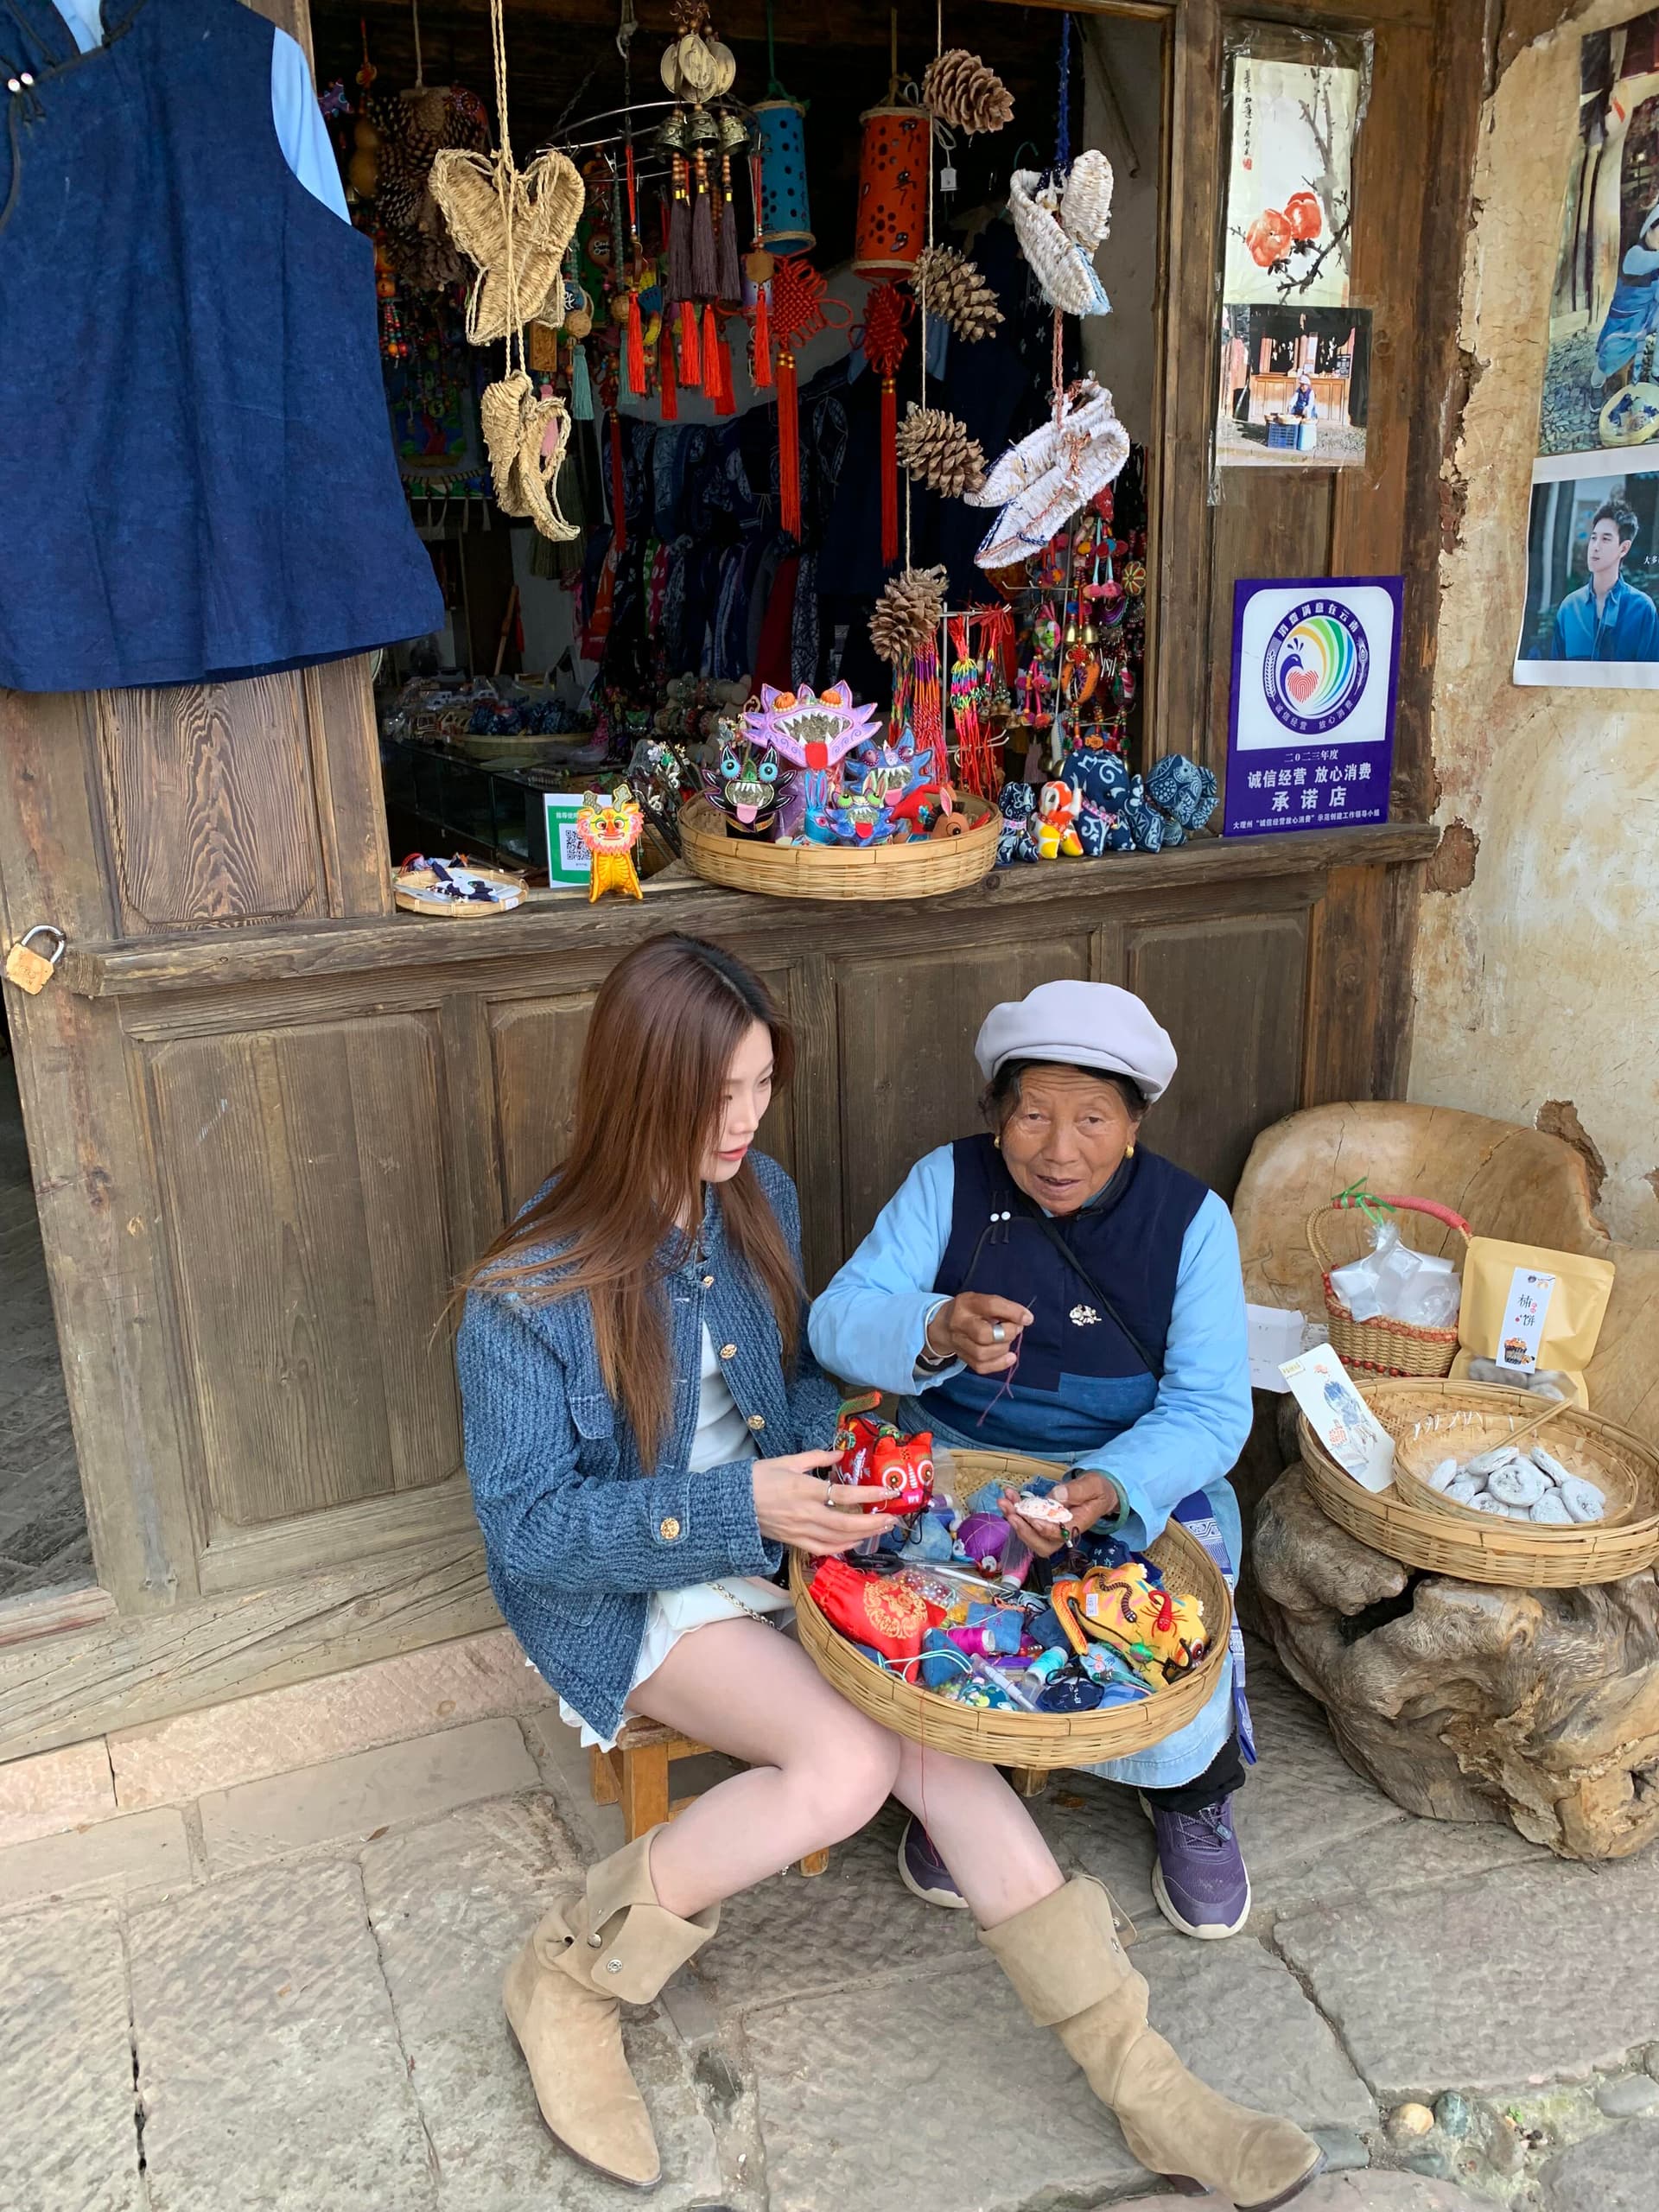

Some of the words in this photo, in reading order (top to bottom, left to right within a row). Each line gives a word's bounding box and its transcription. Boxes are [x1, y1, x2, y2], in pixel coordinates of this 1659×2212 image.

[1248, 767, 1307, 789] 诚信经营
[1314, 762, 1372, 784] 放心消费
[1271, 786, 1347, 812] 承诺店
